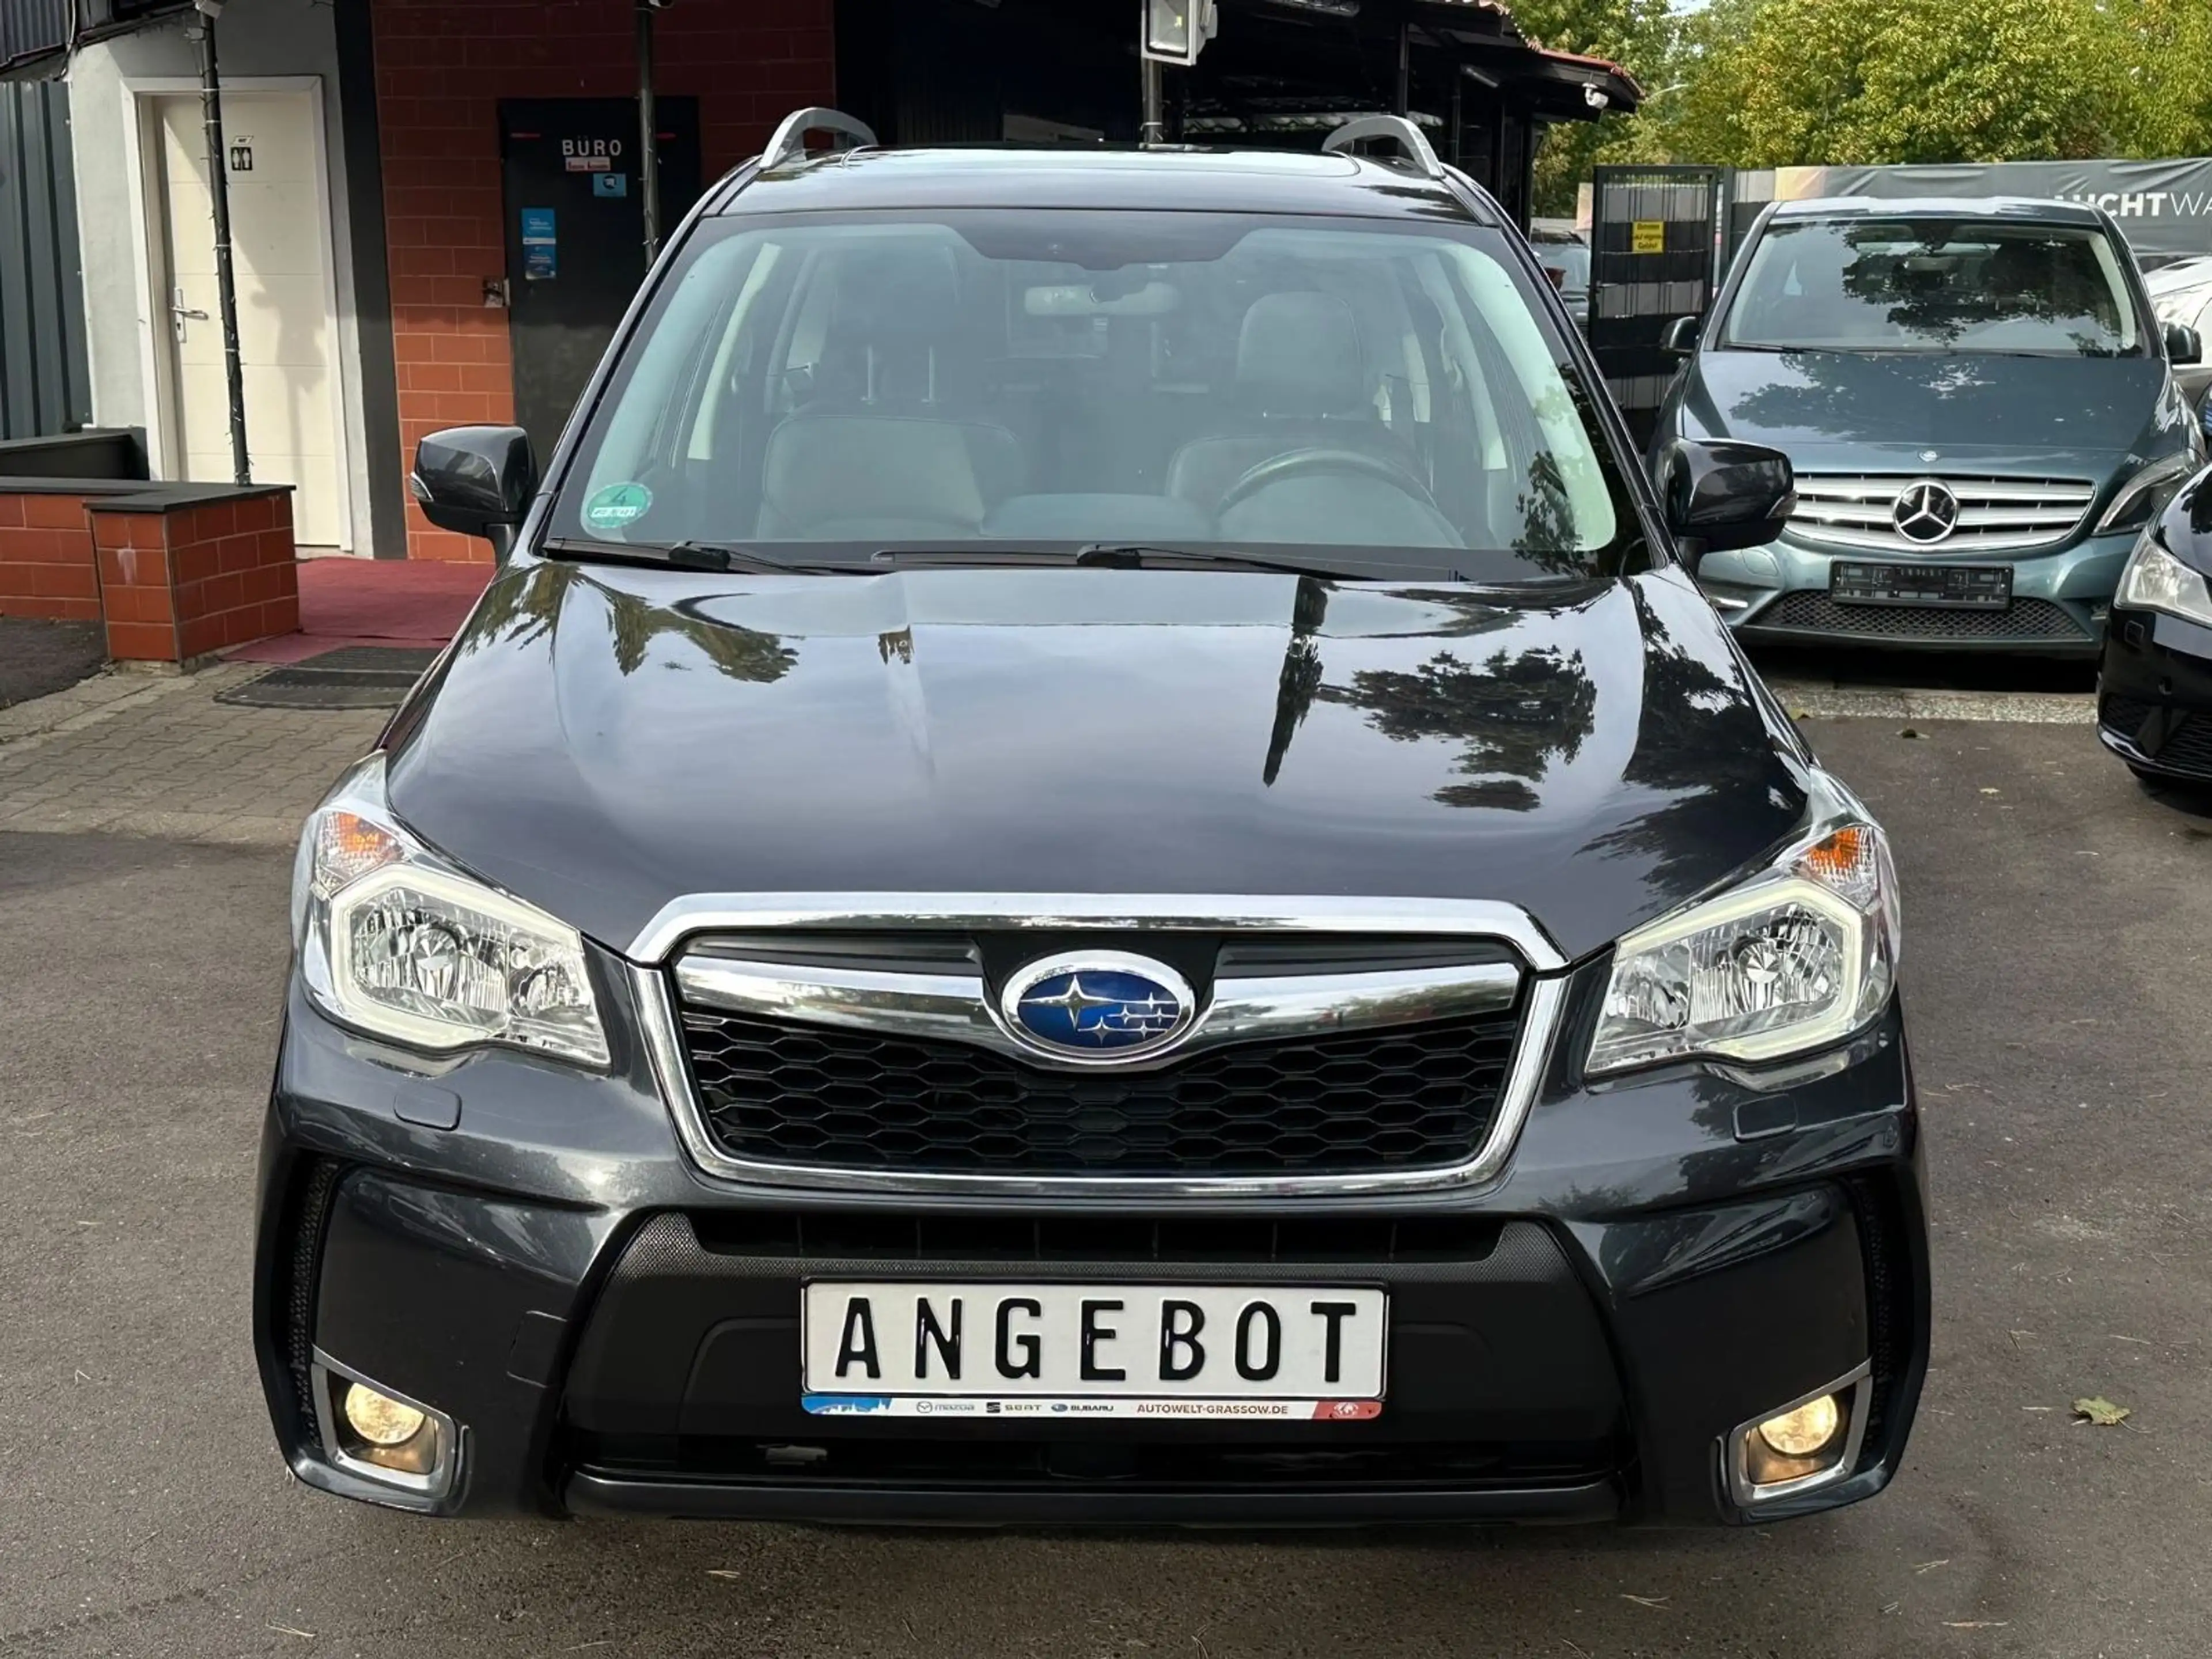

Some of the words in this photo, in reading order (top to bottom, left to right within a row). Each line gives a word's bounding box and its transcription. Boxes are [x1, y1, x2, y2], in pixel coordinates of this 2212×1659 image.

[562, 135, 622, 156] BÜRO
[2054, 192, 2212, 217] CHTW
[835, 1297, 1356, 1383] ANGEBOT
[1137, 1403, 1288, 1415] AUTOWELT-GRASSOW.DE
